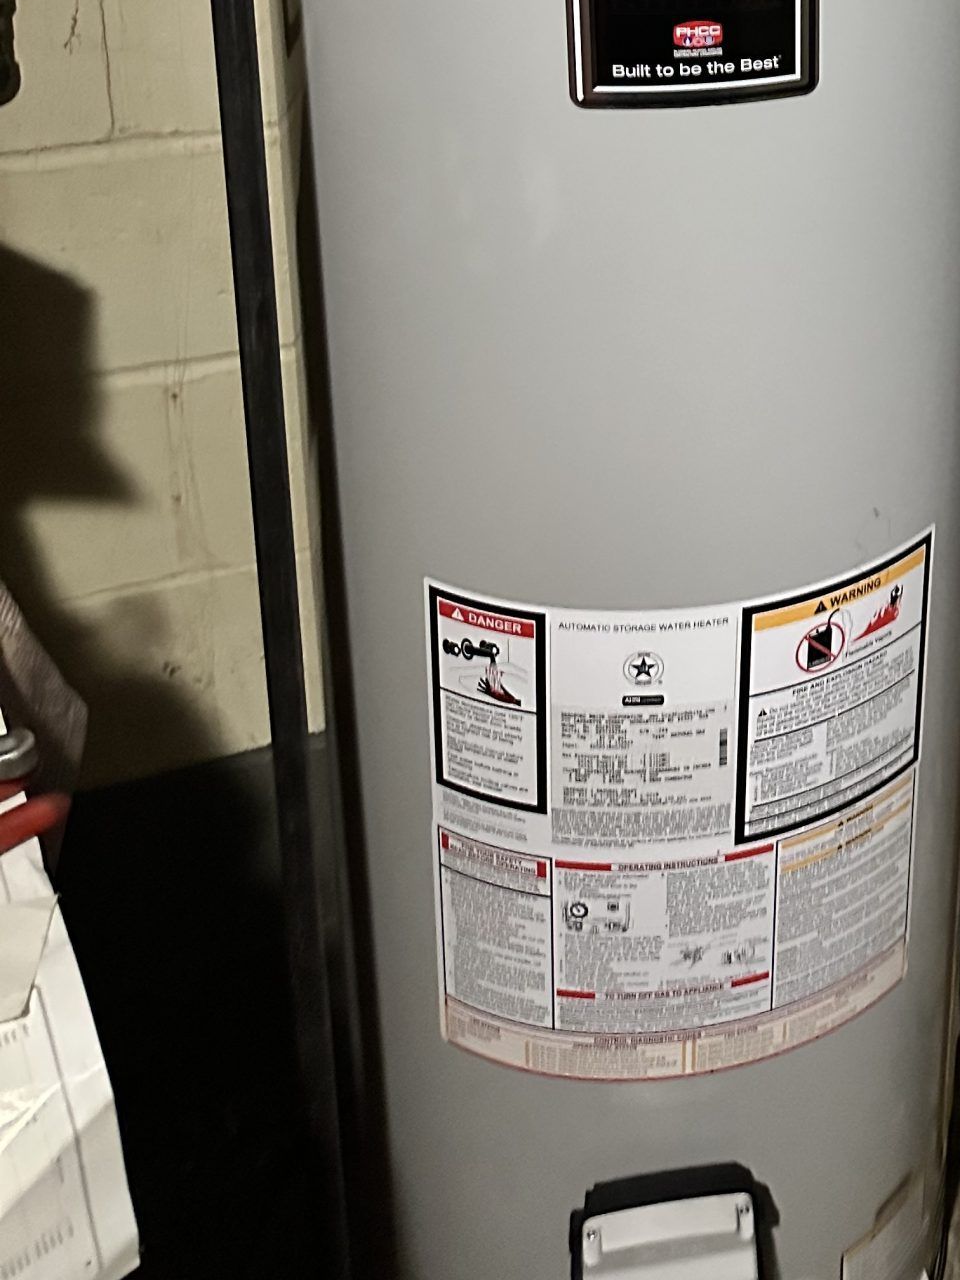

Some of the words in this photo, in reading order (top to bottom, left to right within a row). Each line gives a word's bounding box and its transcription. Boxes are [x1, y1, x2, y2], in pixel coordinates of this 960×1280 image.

[675, 25, 722, 38] PHCC
[612, 63, 651, 78] Built
[655, 64, 675, 78] to
[679, 62, 702, 76] be
[706, 61, 735, 75] the
[740, 56, 780, 73] Best
[830, 577, 882, 608] WARNING
[468, 612, 522, 635] DANGER
[558, 621, 611, 632] AUTOMATIC
[613, 624, 656, 633] STORAGE
[658, 622, 691, 632] WATER
[693, 616, 729, 630] HEATER
[618, 862, 662, 872] OPERATING
[663, 856, 718, 870] INSTRUCTIONS
